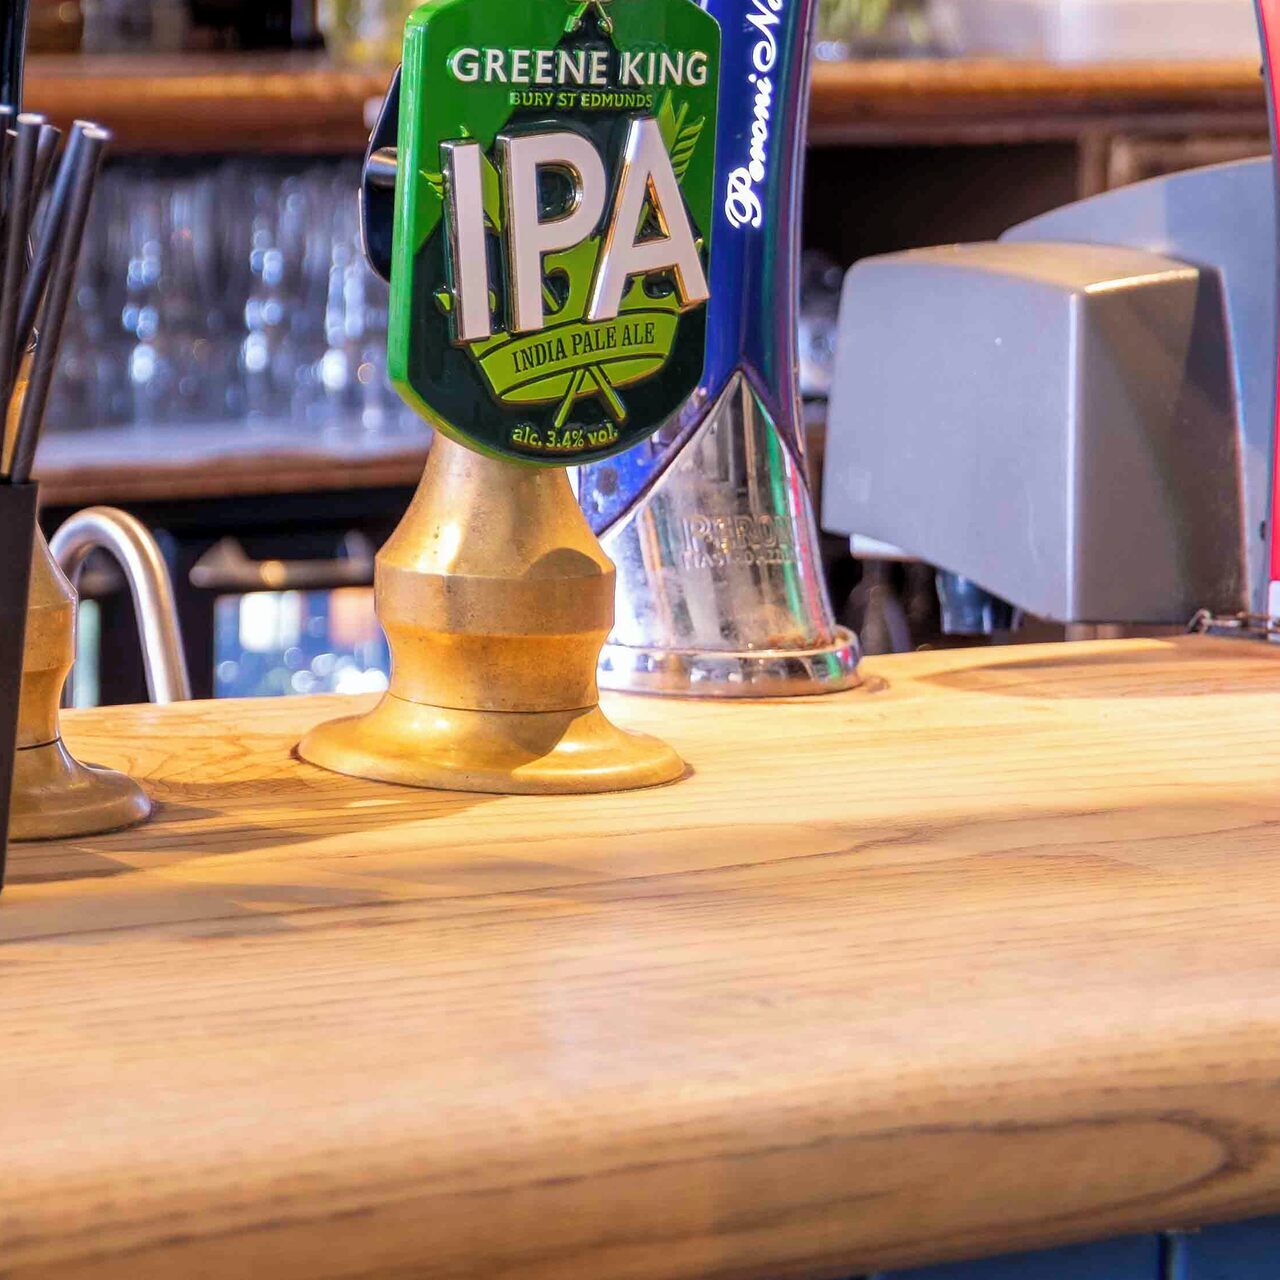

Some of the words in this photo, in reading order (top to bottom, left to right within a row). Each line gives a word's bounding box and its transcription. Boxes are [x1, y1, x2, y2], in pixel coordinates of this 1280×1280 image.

[450, 48, 607, 85] GREENE
[621, 51, 708, 86] KING
[510, 92, 554, 106] BURY
[558, 93, 577, 107] ST
[582, 93, 653, 108] EDMUNDS
[725, 73, 774, 229] Peroni
[440, 119, 710, 346] IPA
[512, 338, 568, 374] INDIA
[571, 326, 617, 356] PALE
[621, 322, 655, 346] ALE
[512, 426, 542, 446] alc.
[546, 430, 585, 448] 3.4%
[587, 423, 618, 445] vol.
